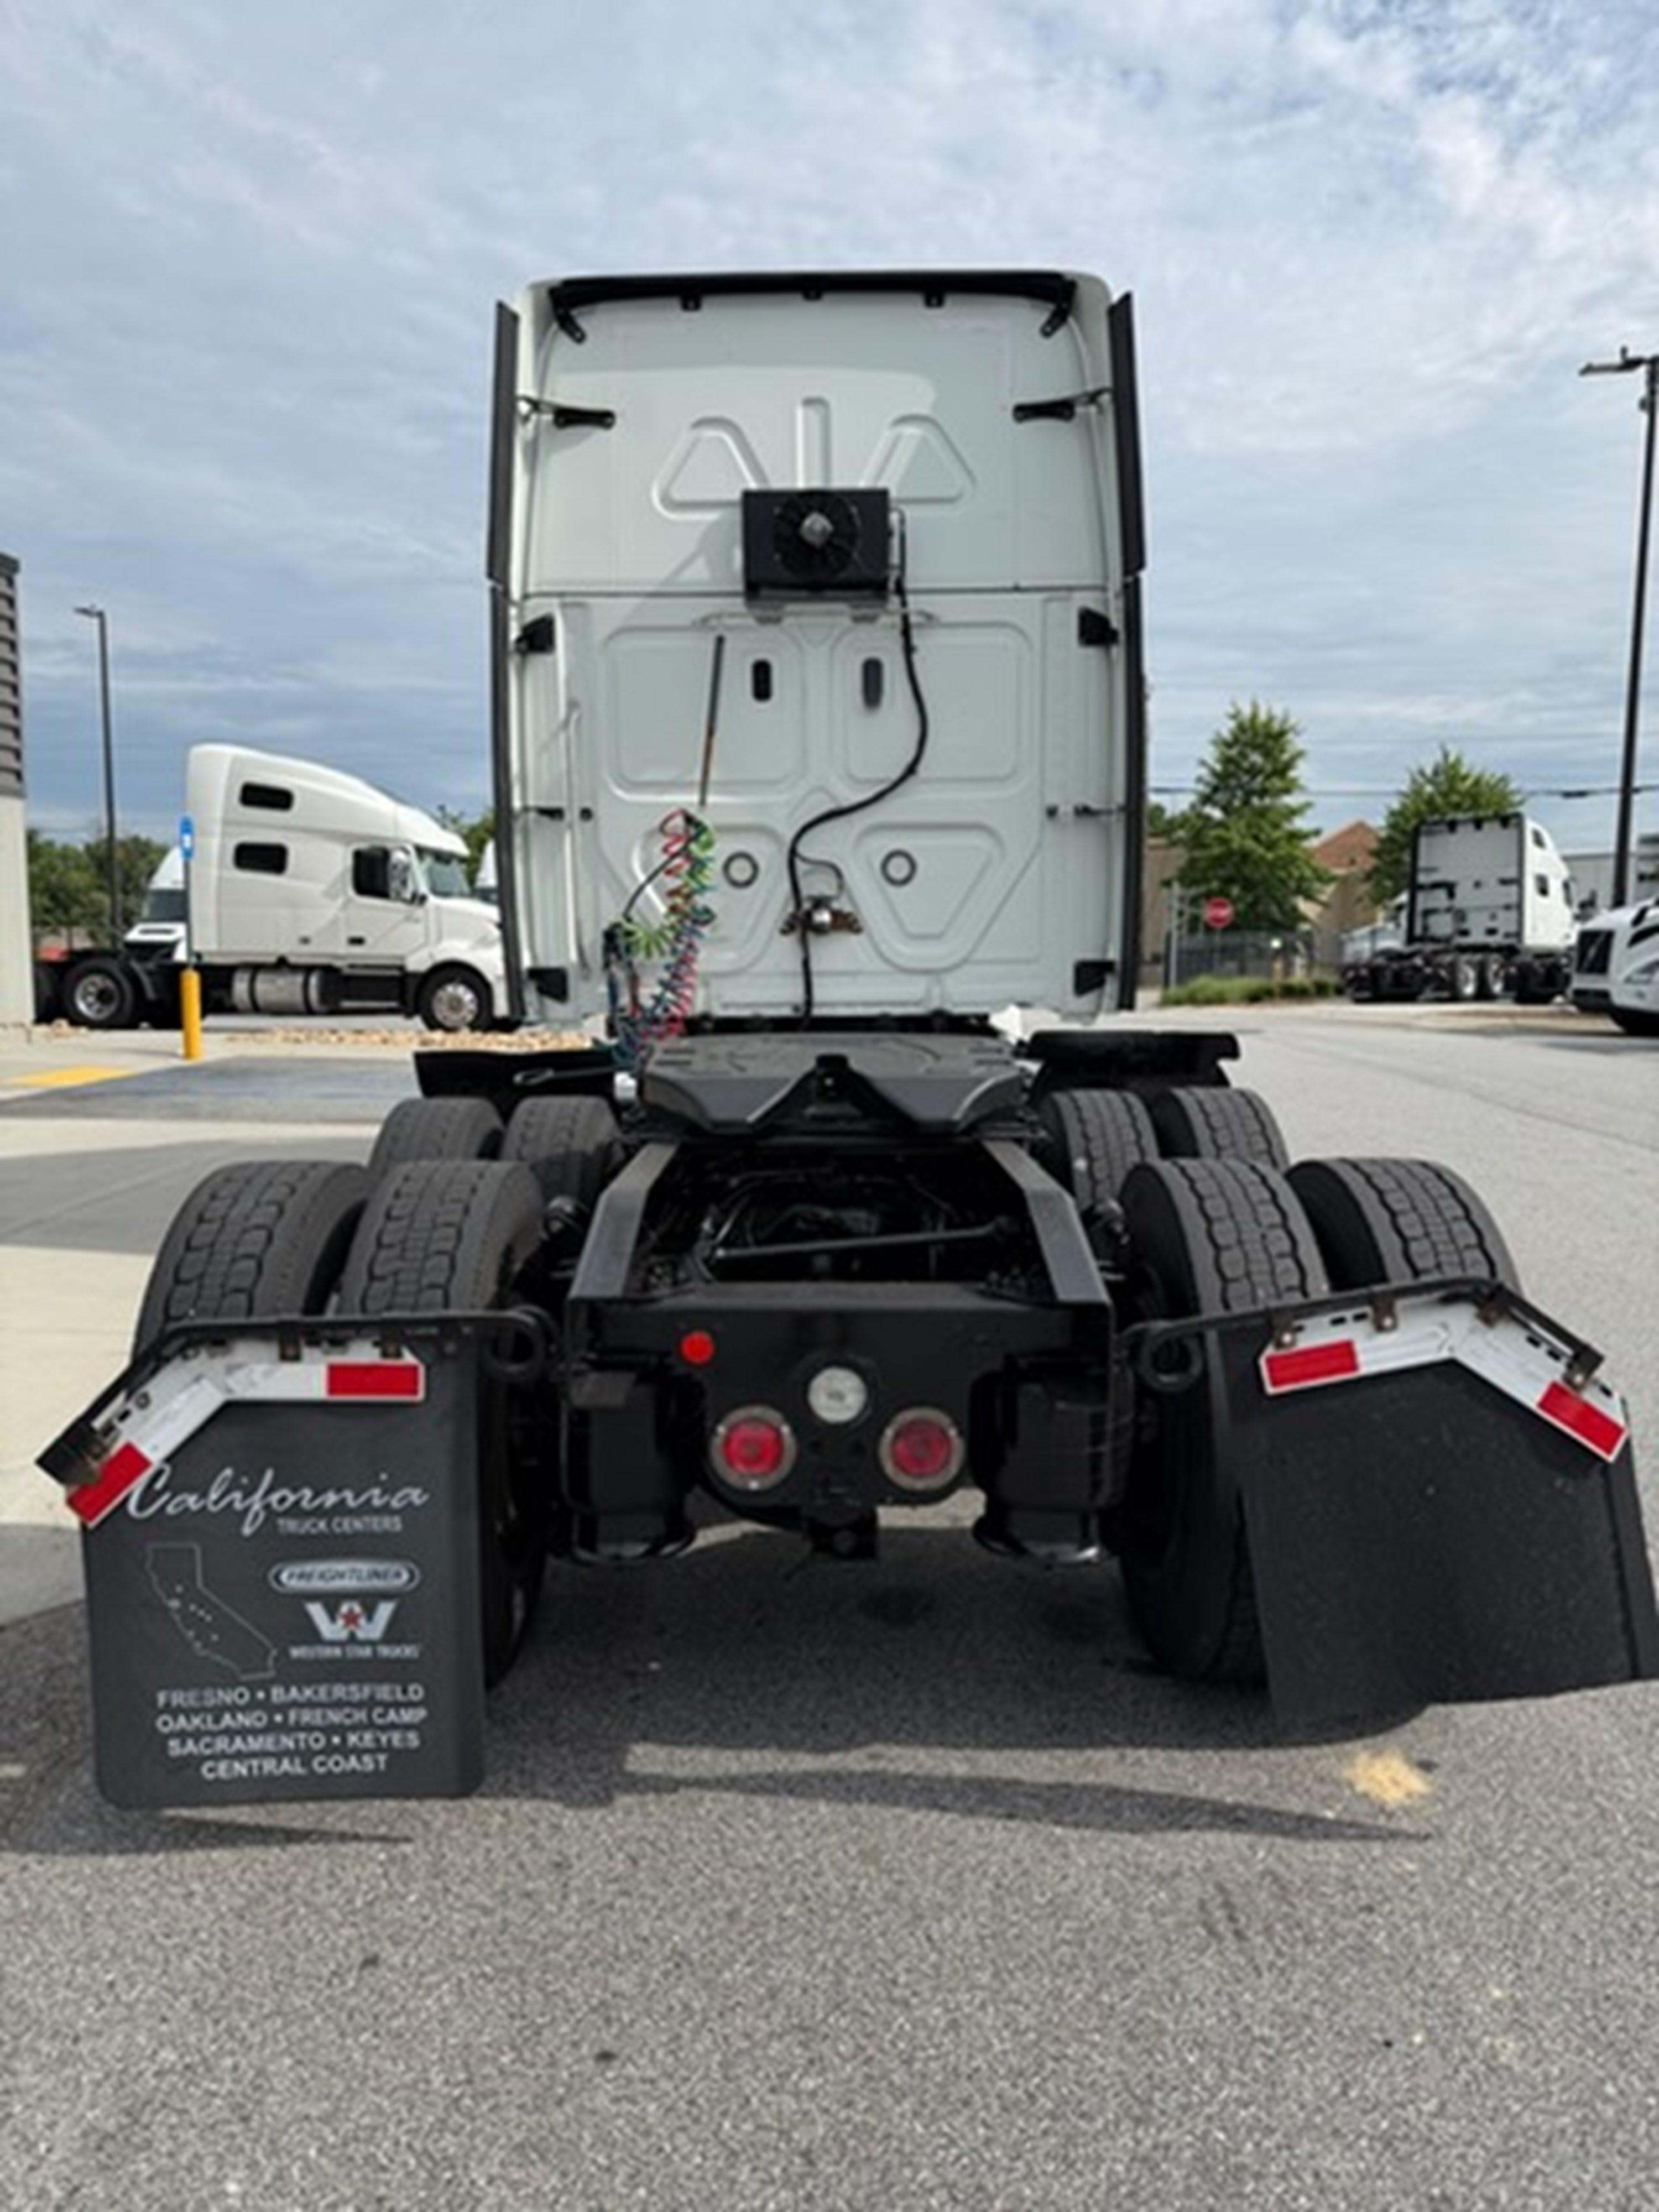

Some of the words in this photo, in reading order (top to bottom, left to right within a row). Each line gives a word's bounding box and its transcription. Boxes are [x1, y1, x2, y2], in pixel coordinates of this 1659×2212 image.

[127, 1463, 430, 1536] California
[277, 1517, 328, 1534] TRUCK
[332, 1515, 403, 1533] CENTERS
[285, 1567, 405, 1583] FREIGHTLINER
[157, 1686, 251, 1709] FRESNO
[271, 1683, 425, 1704] BAKERSFIELD
[156, 1710, 268, 1733] OAKLAND
[288, 1705, 369, 1726] FRENCH
[372, 1705, 427, 1725] CAMP
[168, 1731, 327, 1757] SACRAMENTO
[347, 1729, 420, 1750] KEYES
[201, 1757, 307, 1780] CENTRAL
[311, 1754, 388, 1773] COAST
